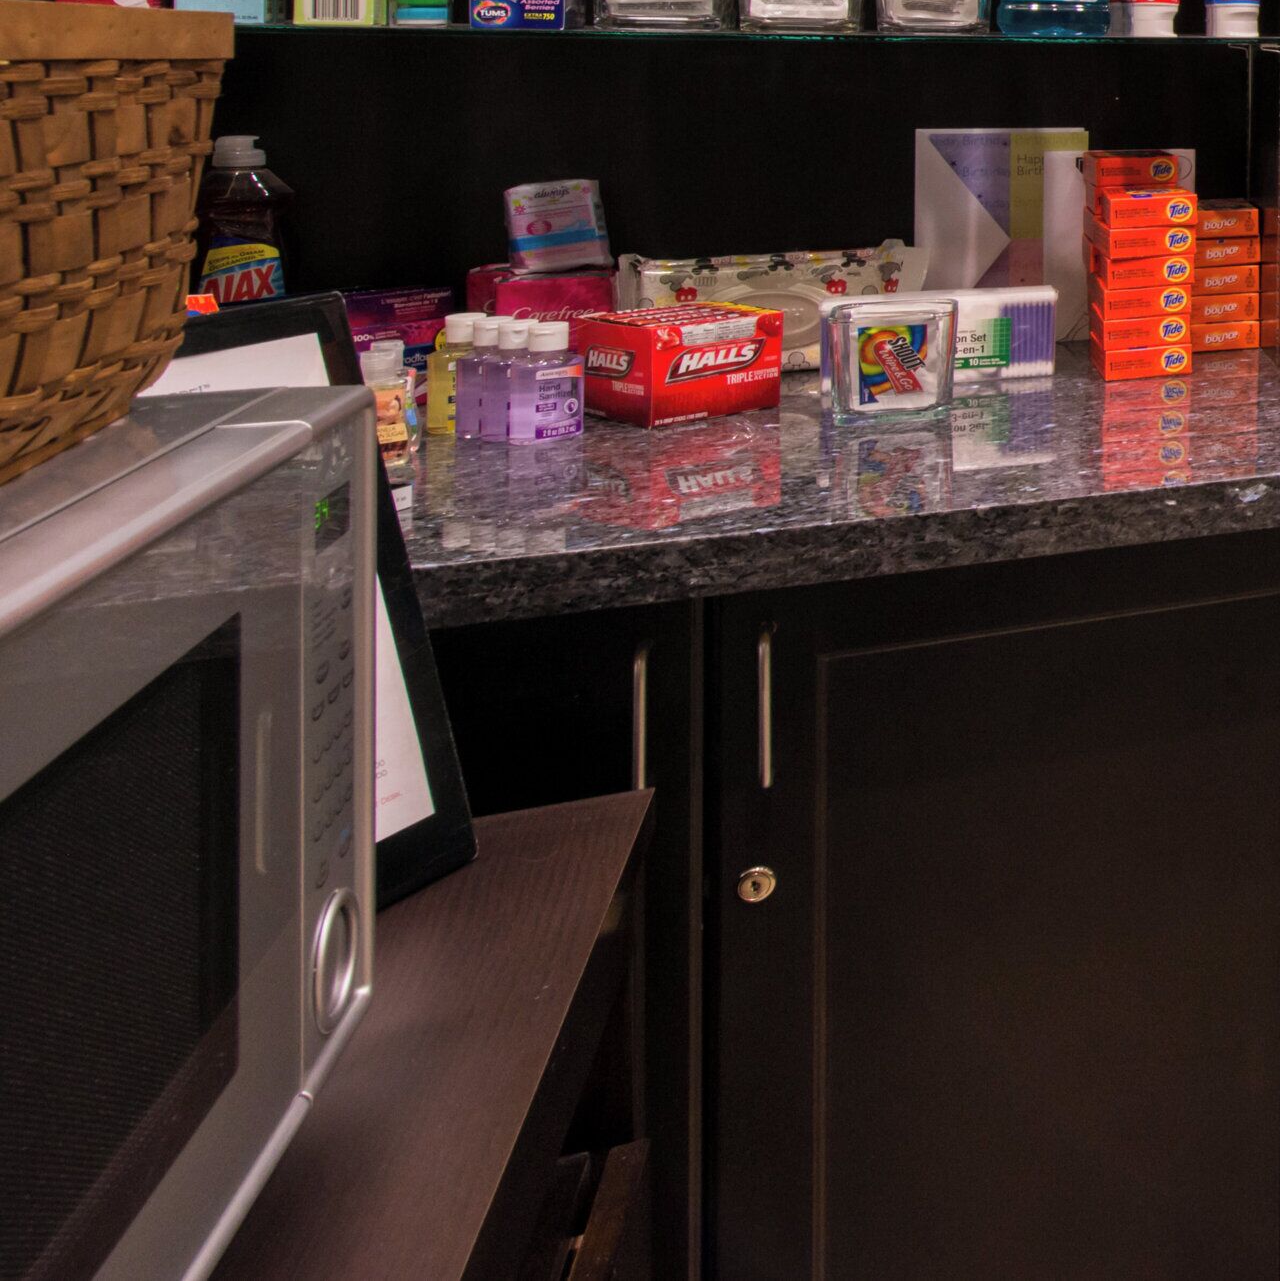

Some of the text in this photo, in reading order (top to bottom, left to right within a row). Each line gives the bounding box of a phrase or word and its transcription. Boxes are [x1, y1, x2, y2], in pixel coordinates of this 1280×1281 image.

[480, 9, 506, 18] TUMS
[1152, 163, 1175, 175] Tide
[534, 185, 571, 202] always
[1169, 203, 1191, 218] Tide
[1203, 217, 1237, 231] bounce
[1168, 233, 1190, 247] Tide
[1205, 246, 1240, 260] bounce
[1166, 264, 1188, 278] Tide
[1204, 274, 1239, 289] bounce
[1163, 293, 1185, 306] Tide
[511, 305, 595, 320] Carefree
[1204, 302, 1239, 317] bounce
[1162, 323, 1184, 336] Tide
[587, 351, 630, 371] HALLS
[678, 343, 757, 373] HALLS
[1164, 353, 1186, 367] Tide
[726, 372, 754, 386] TRIPLE
[538, 382, 562, 394] Hand
